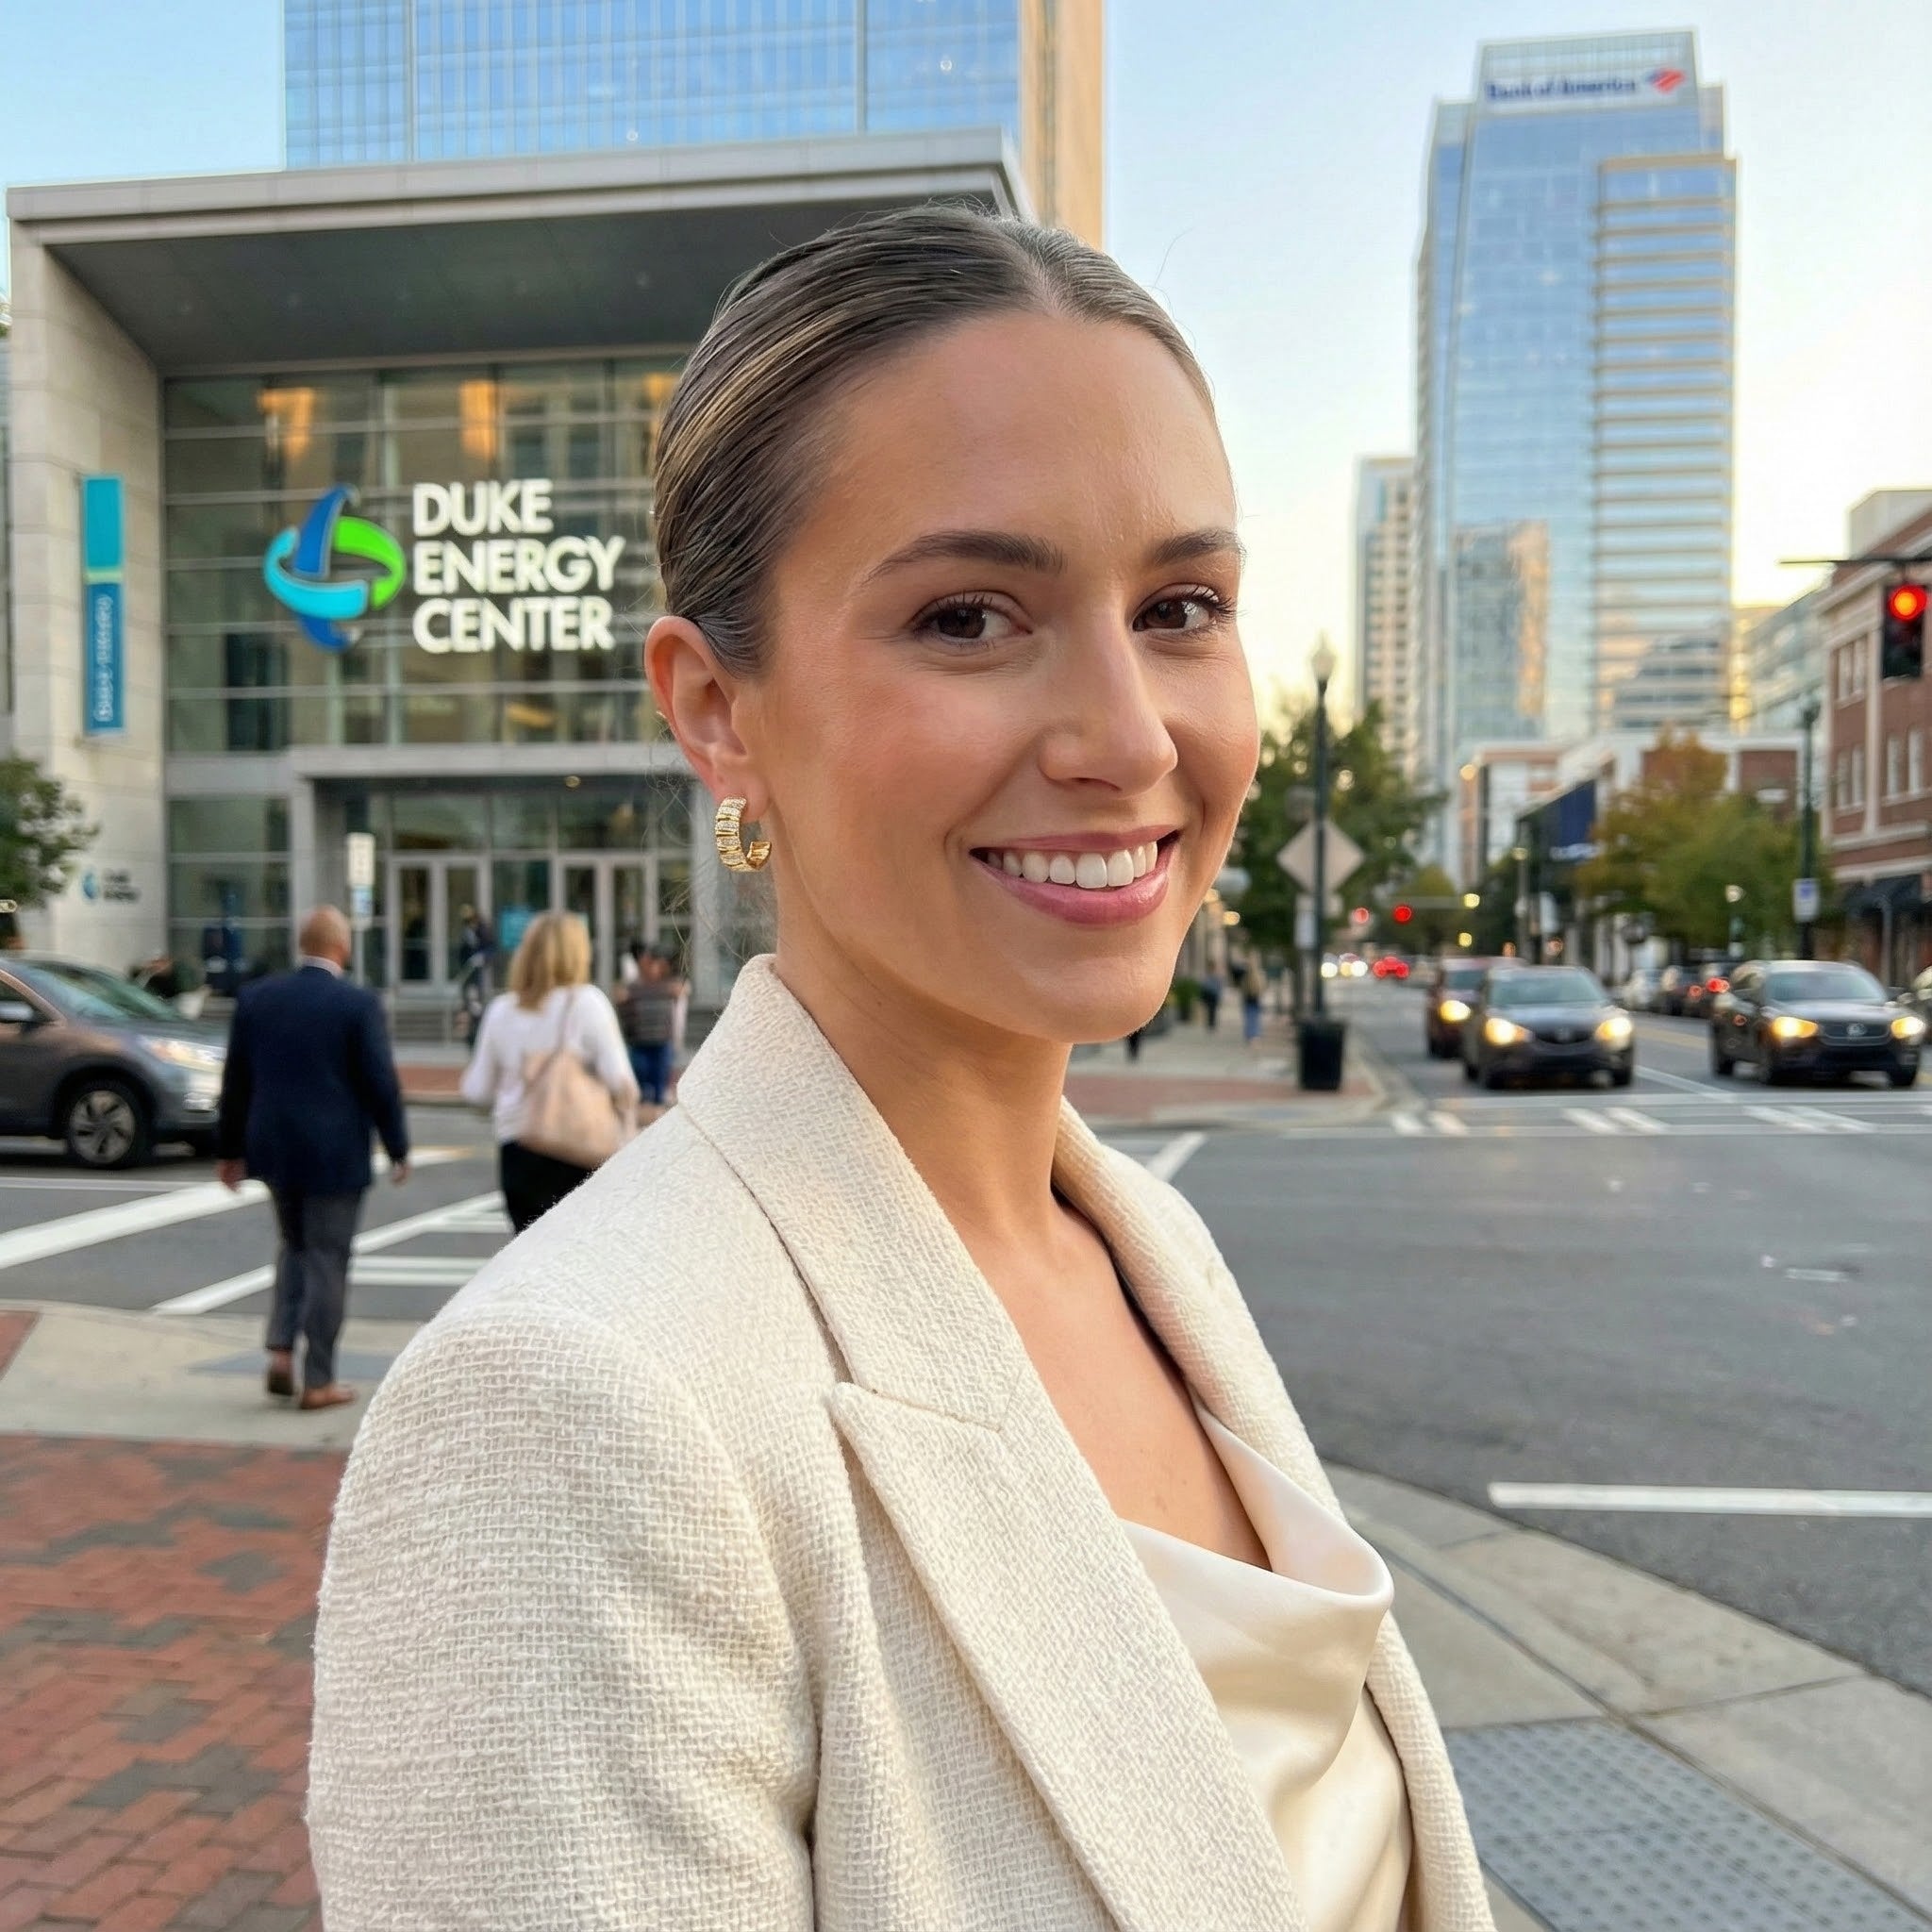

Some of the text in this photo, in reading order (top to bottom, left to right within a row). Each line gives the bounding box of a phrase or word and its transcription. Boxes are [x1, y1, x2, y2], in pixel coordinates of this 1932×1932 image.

[413, 478, 554, 537] DUKE
[413, 535, 626, 595] ENERGY
[412, 595, 616, 654] CENTER
